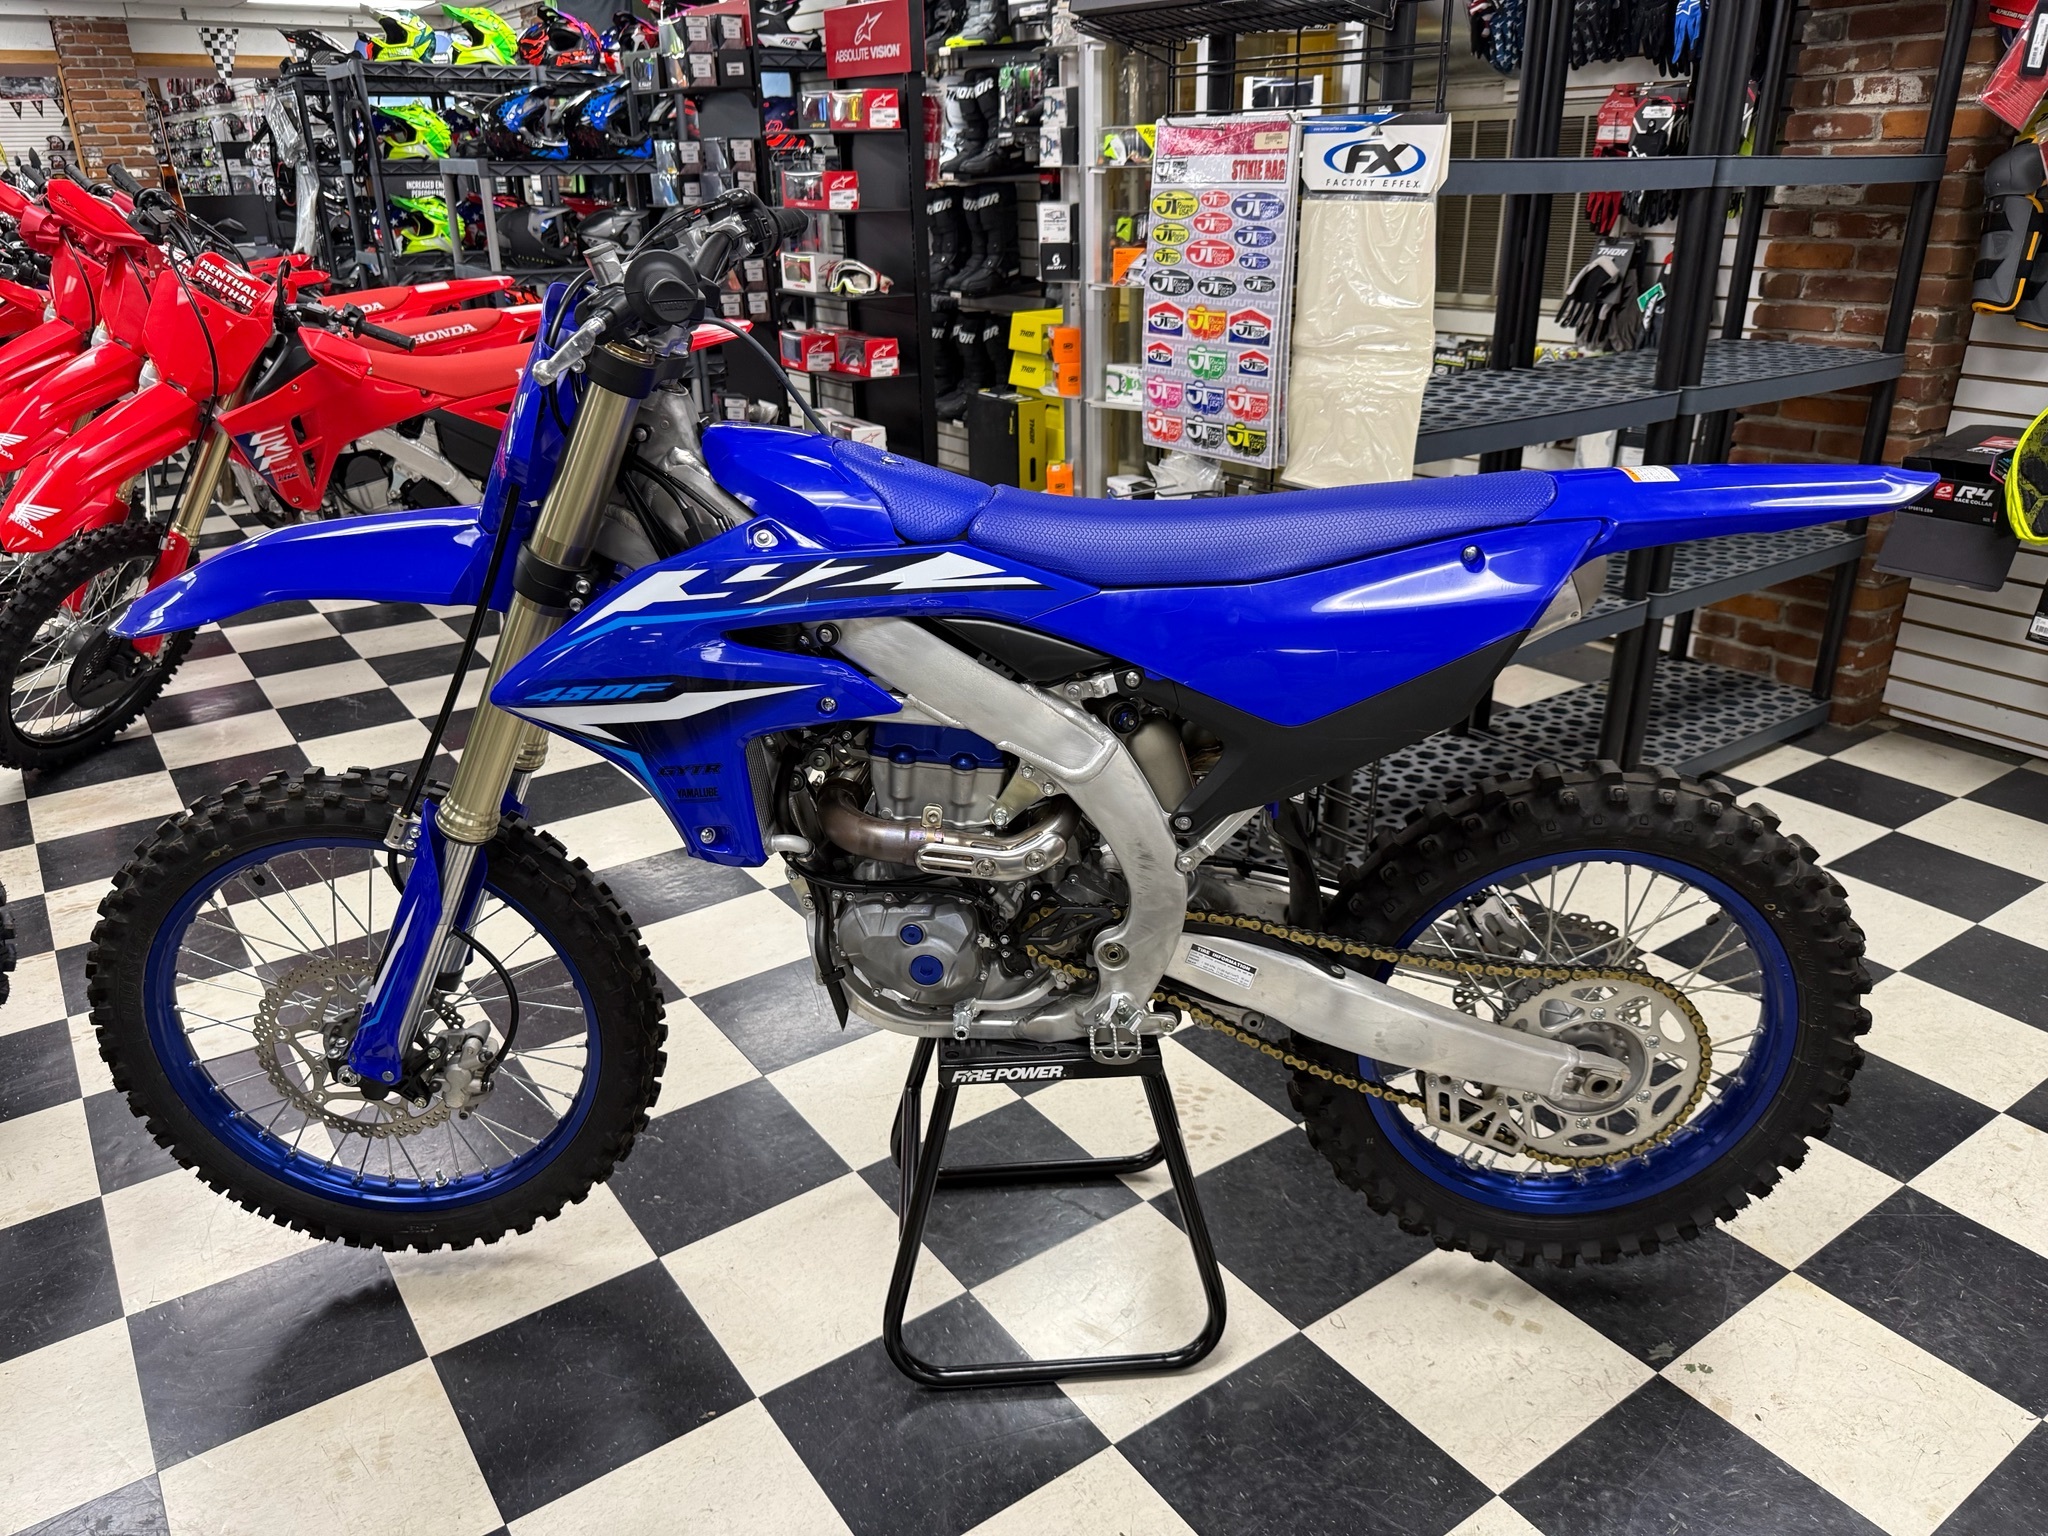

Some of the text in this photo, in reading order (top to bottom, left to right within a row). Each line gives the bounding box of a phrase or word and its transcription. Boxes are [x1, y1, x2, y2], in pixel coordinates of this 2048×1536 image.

[835, 44, 900, 63] ABSOLUTE VISION
[1344, 144, 1406, 173] FX
[406, 180, 434, 191] INCREASED
[1326, 178, 1375, 187] FACTORY
[1597, 248, 1628, 257] THOR
[200, 260, 258, 299] RENTHAL
[195, 270, 254, 309] RENTHAL
[410, 323, 478, 345] HONDA
[1019, 329, 1035, 338] THOR
[1021, 365, 1036, 374] THOR
[249, 425, 293, 472] CRF
[1956, 485, 1995, 501] R4
[1954, 497, 1993, 508] RACE COLLAR
[524, 682, 674, 701] 450F
[657, 763, 721, 776] GYTR
[677, 787, 719, 798] YAMALUBE
[1197, 946, 1251, 972] TIRE INFORMATION
